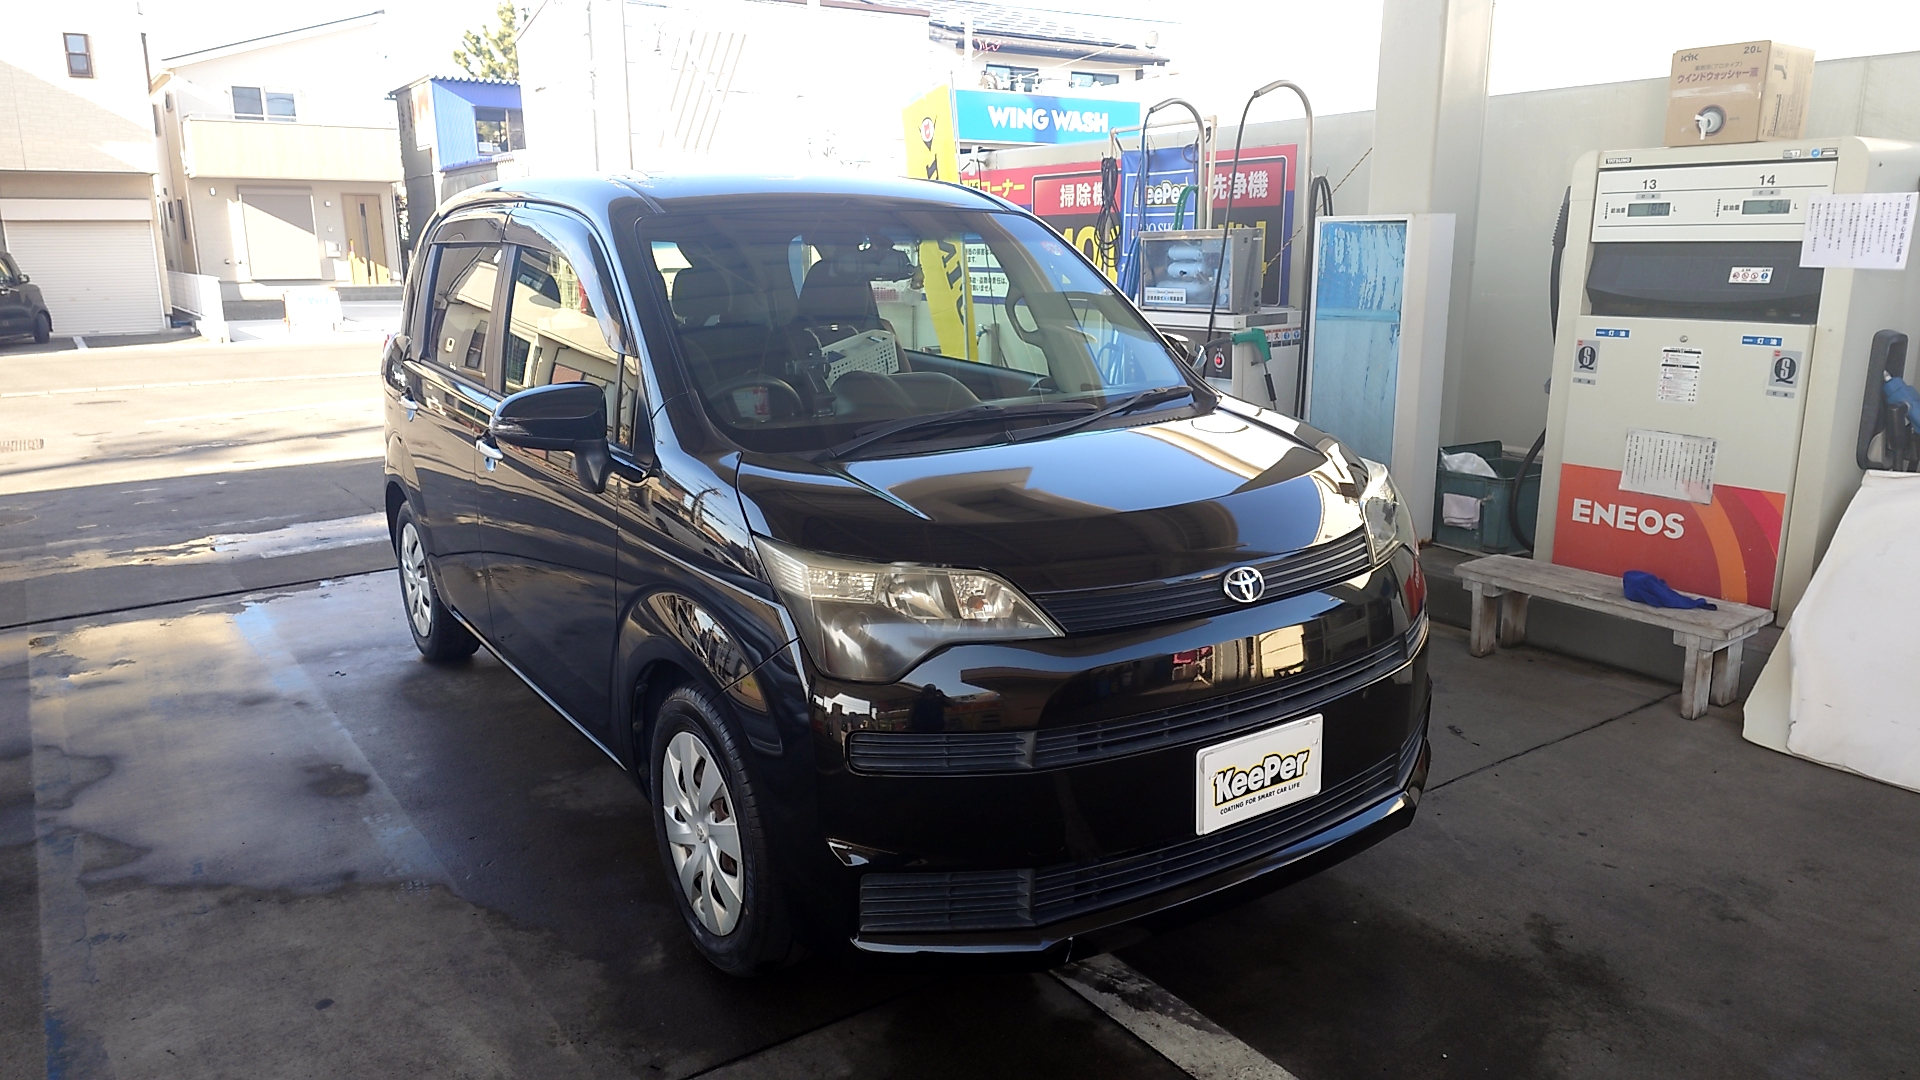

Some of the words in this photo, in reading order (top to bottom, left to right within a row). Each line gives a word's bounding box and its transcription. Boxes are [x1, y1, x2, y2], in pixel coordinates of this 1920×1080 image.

[1680, 53, 1699, 62] KYK
[1677, 67, 1759, 83] ウインドウォッシャー液
[988, 106, 1049, 130] WING
[1051, 110, 1108, 133] WASH
[1642, 179, 1657, 190] 13
[1759, 174, 1776, 186] 14
[1572, 498, 1685, 539] ENEOS
[1214, 749, 1310, 806] KeePer
[1220, 801, 1244, 815] COATING
[1245, 797, 1257, 806] FOR
[1257, 790, 1275, 802] SMART
[1276, 785, 1288, 795] CAR
[1288, 781, 1301, 790] LIFE
